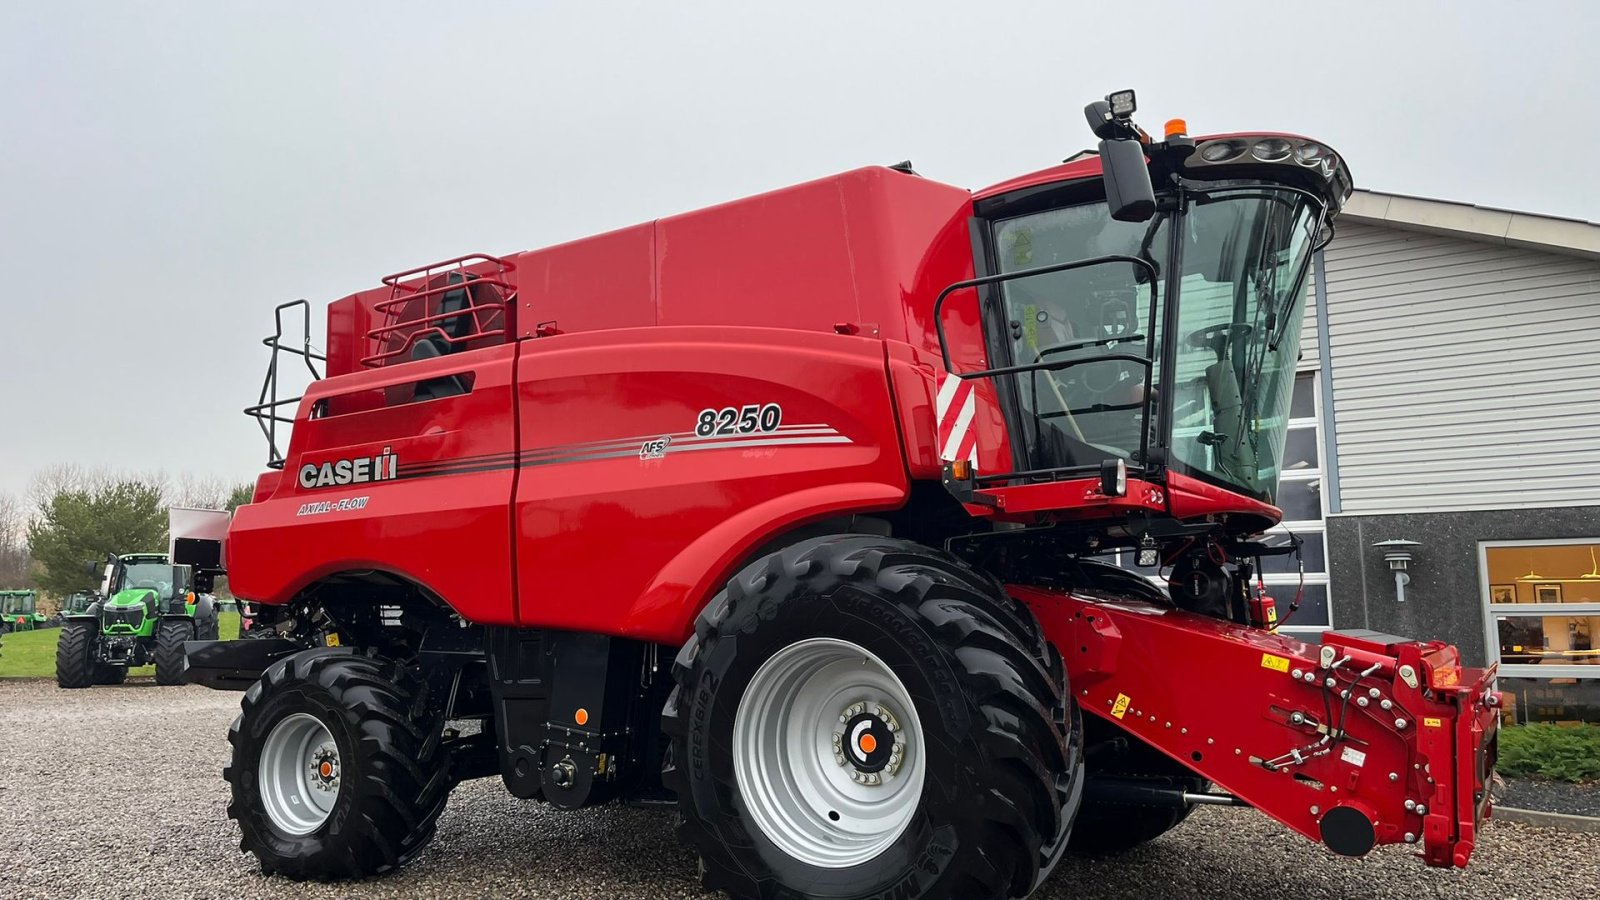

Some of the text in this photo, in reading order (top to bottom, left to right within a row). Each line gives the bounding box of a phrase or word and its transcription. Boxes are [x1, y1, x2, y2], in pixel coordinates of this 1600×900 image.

[694, 403, 782, 437] 8250
[640, 440, 664, 454] AFS
[300, 458, 370, 488] CASE
[693, 668, 720, 780] CEREXBIB 2
